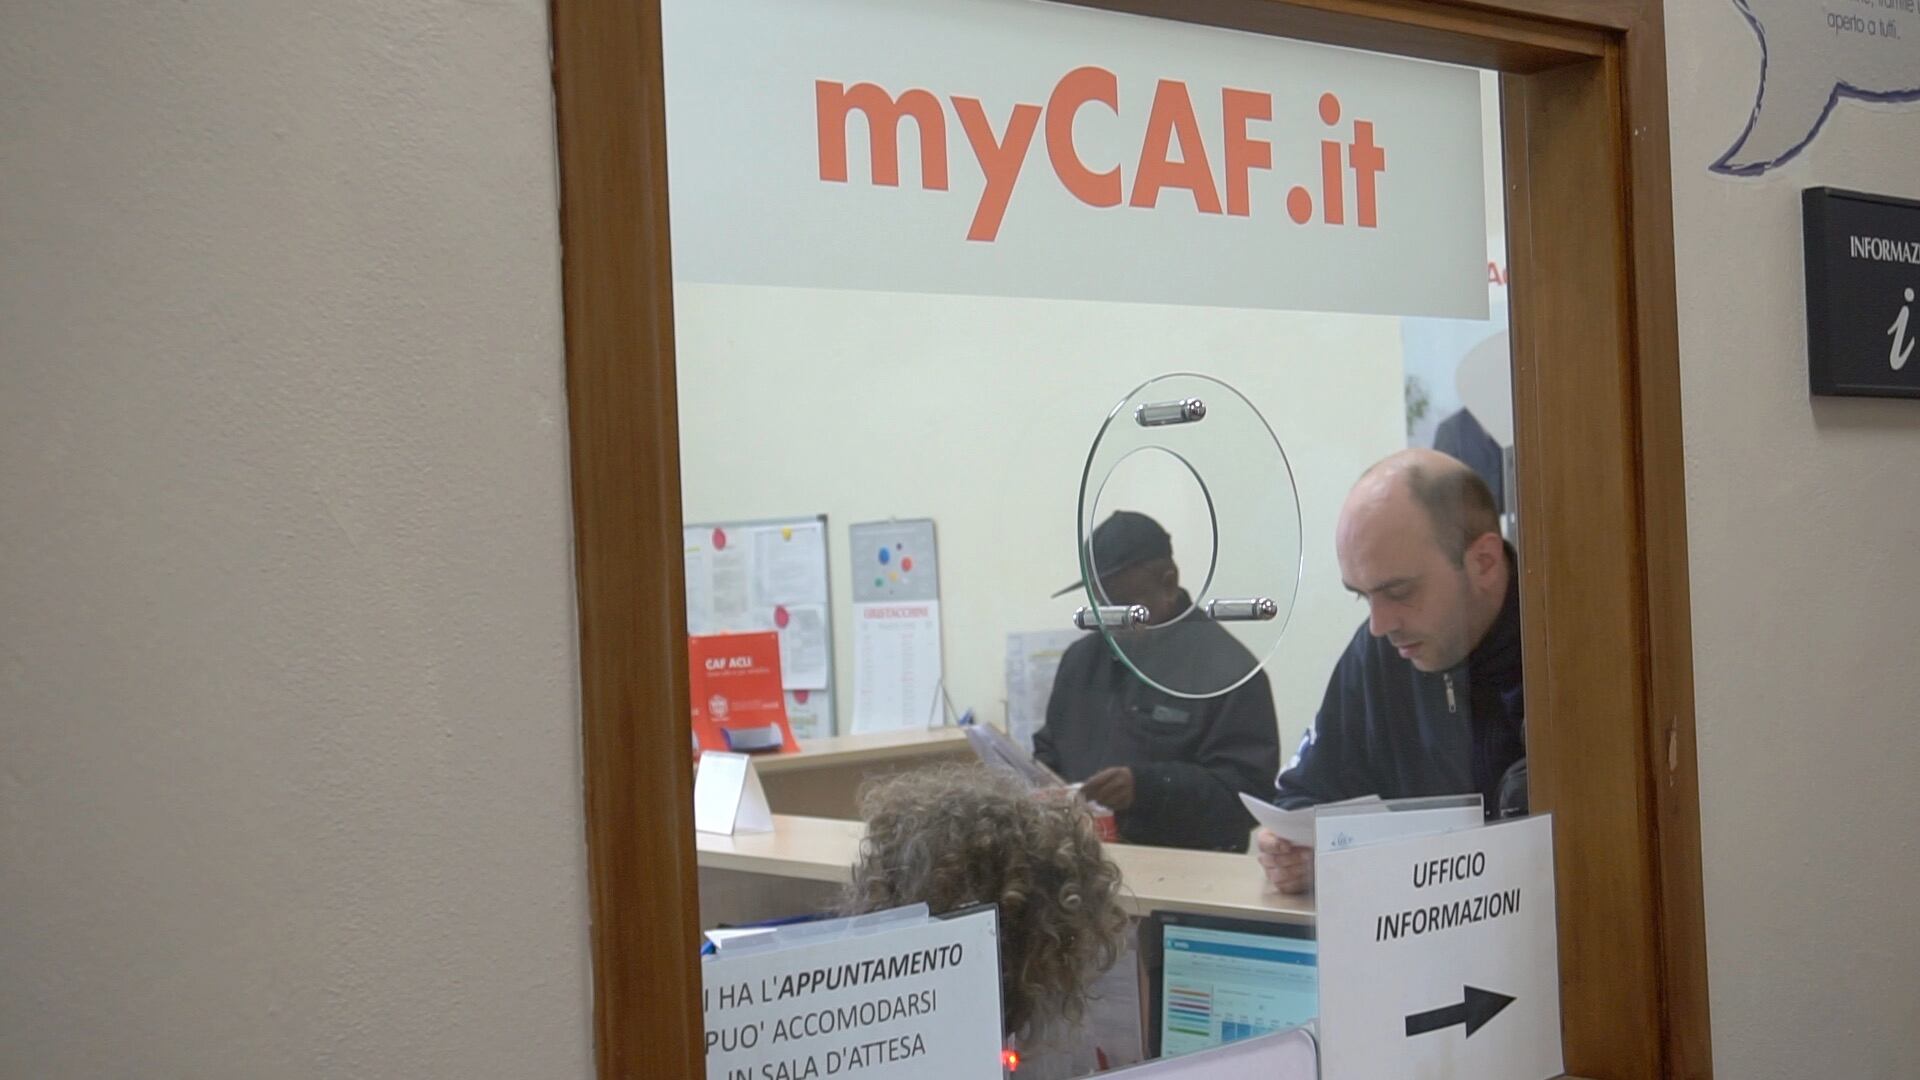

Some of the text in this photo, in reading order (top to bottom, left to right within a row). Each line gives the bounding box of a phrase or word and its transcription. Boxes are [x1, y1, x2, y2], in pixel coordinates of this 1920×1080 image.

[1827, 12, 1865, 36] aperto
[1867, 20, 1876, 35] a
[815, 65, 1385, 242] myCAF.it
[1850, 235, 1920, 264] INFORMAZ
[1413, 851, 1486, 889] UFFICIO
[1375, 888, 1521, 941] INFORMAZIONI
[719, 981, 753, 1010] HA
[705, 989, 938, 1055] PUO' ACCOMODARSI
[761, 1055, 818, 1080] SALA
[826, 1033, 926, 1076] D'ATTESA
